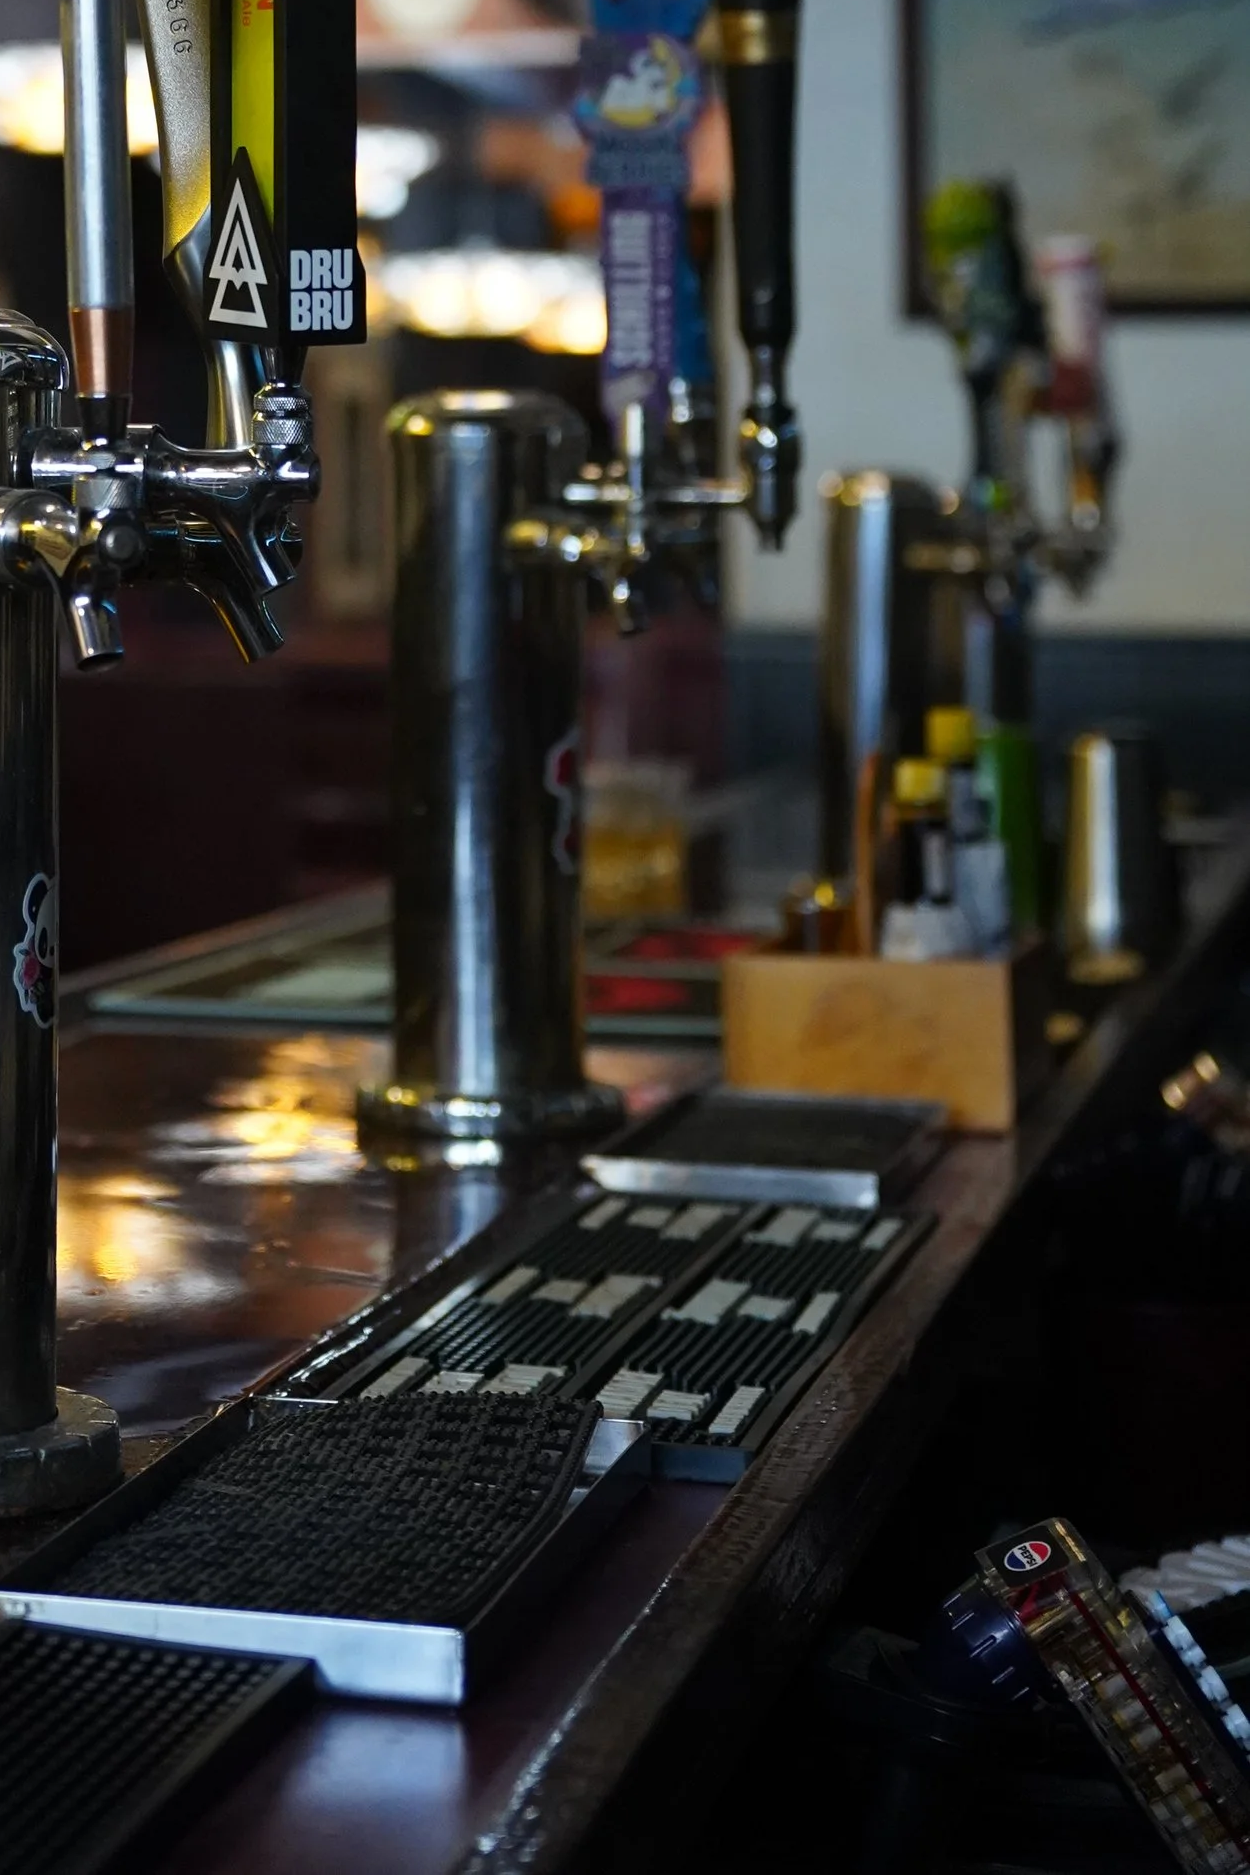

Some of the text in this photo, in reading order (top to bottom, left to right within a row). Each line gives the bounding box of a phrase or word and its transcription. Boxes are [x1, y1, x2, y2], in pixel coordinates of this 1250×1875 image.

[241, 0, 253, 27] Ale
[290, 248, 354, 290] DRU
[290, 290, 354, 332] BRU
[1017, 1545, 1039, 1566] PEPSI
